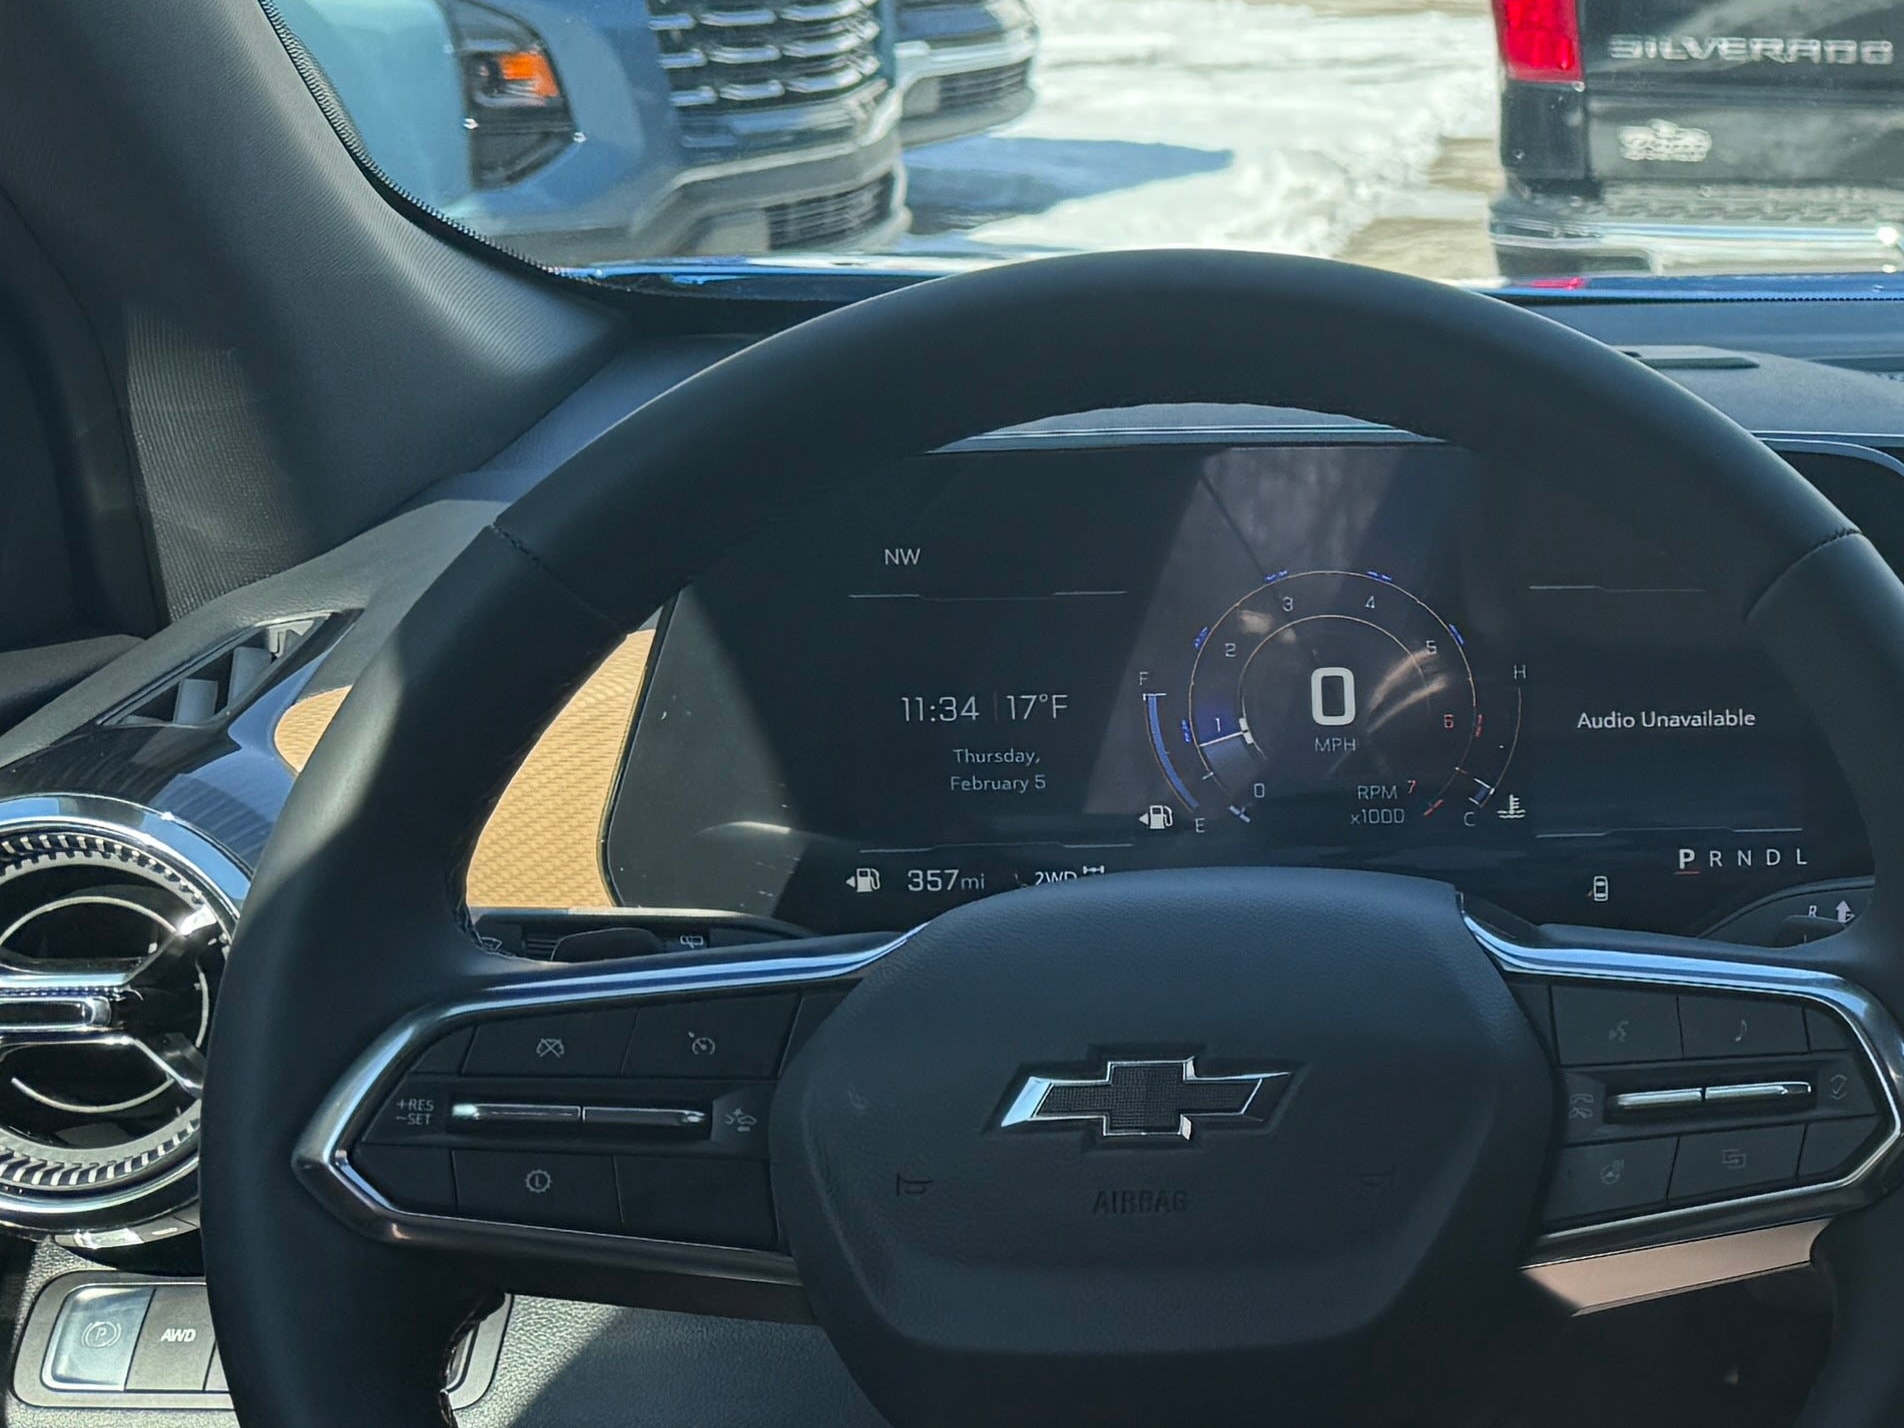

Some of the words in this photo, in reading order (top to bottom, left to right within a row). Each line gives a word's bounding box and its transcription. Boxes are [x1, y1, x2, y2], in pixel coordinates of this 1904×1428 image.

[1609, 33, 1894, 65] SILVERADO
[884, 547, 921, 565] NW
[1281, 596, 1294, 612] 3
[1364, 595, 1377, 610] 4
[1224, 643, 1237, 658] 2
[1425, 639, 1438, 656] 5
[1139, 671, 1149, 686] F
[1513, 665, 1527, 680] H
[1310, 666, 1357, 726] 0
[900, 695, 981, 722] 11:34
[1005, 692, 1069, 721] 17°F
[1443, 714, 1455, 730] 6
[1576, 707, 1634, 729] Audio
[1640, 705, 1757, 728] Unavailable
[1314, 736, 1358, 753] MPH
[952, 748, 1041, 766] Thursday,
[949, 775, 1030, 794] February
[1034, 774, 1047, 790] 5
[1357, 784, 1398, 800] RPM
[1407, 779, 1417, 795] 7
[1350, 808, 1406, 825] x1000
[1463, 812, 1476, 828] C
[1194, 818, 1206, 834] E
[1678, 848, 1696, 870] P
[1709, 850, 1723, 868] R
[1737, 849, 1752, 867] N
[1765, 848, 1781, 866] D
[1795, 848, 1808, 866] L
[1034, 870, 1079, 886] 2WD
[1091, 1189, 1188, 1215] AIRBAG
[160, 1325, 197, 1344] AWD
